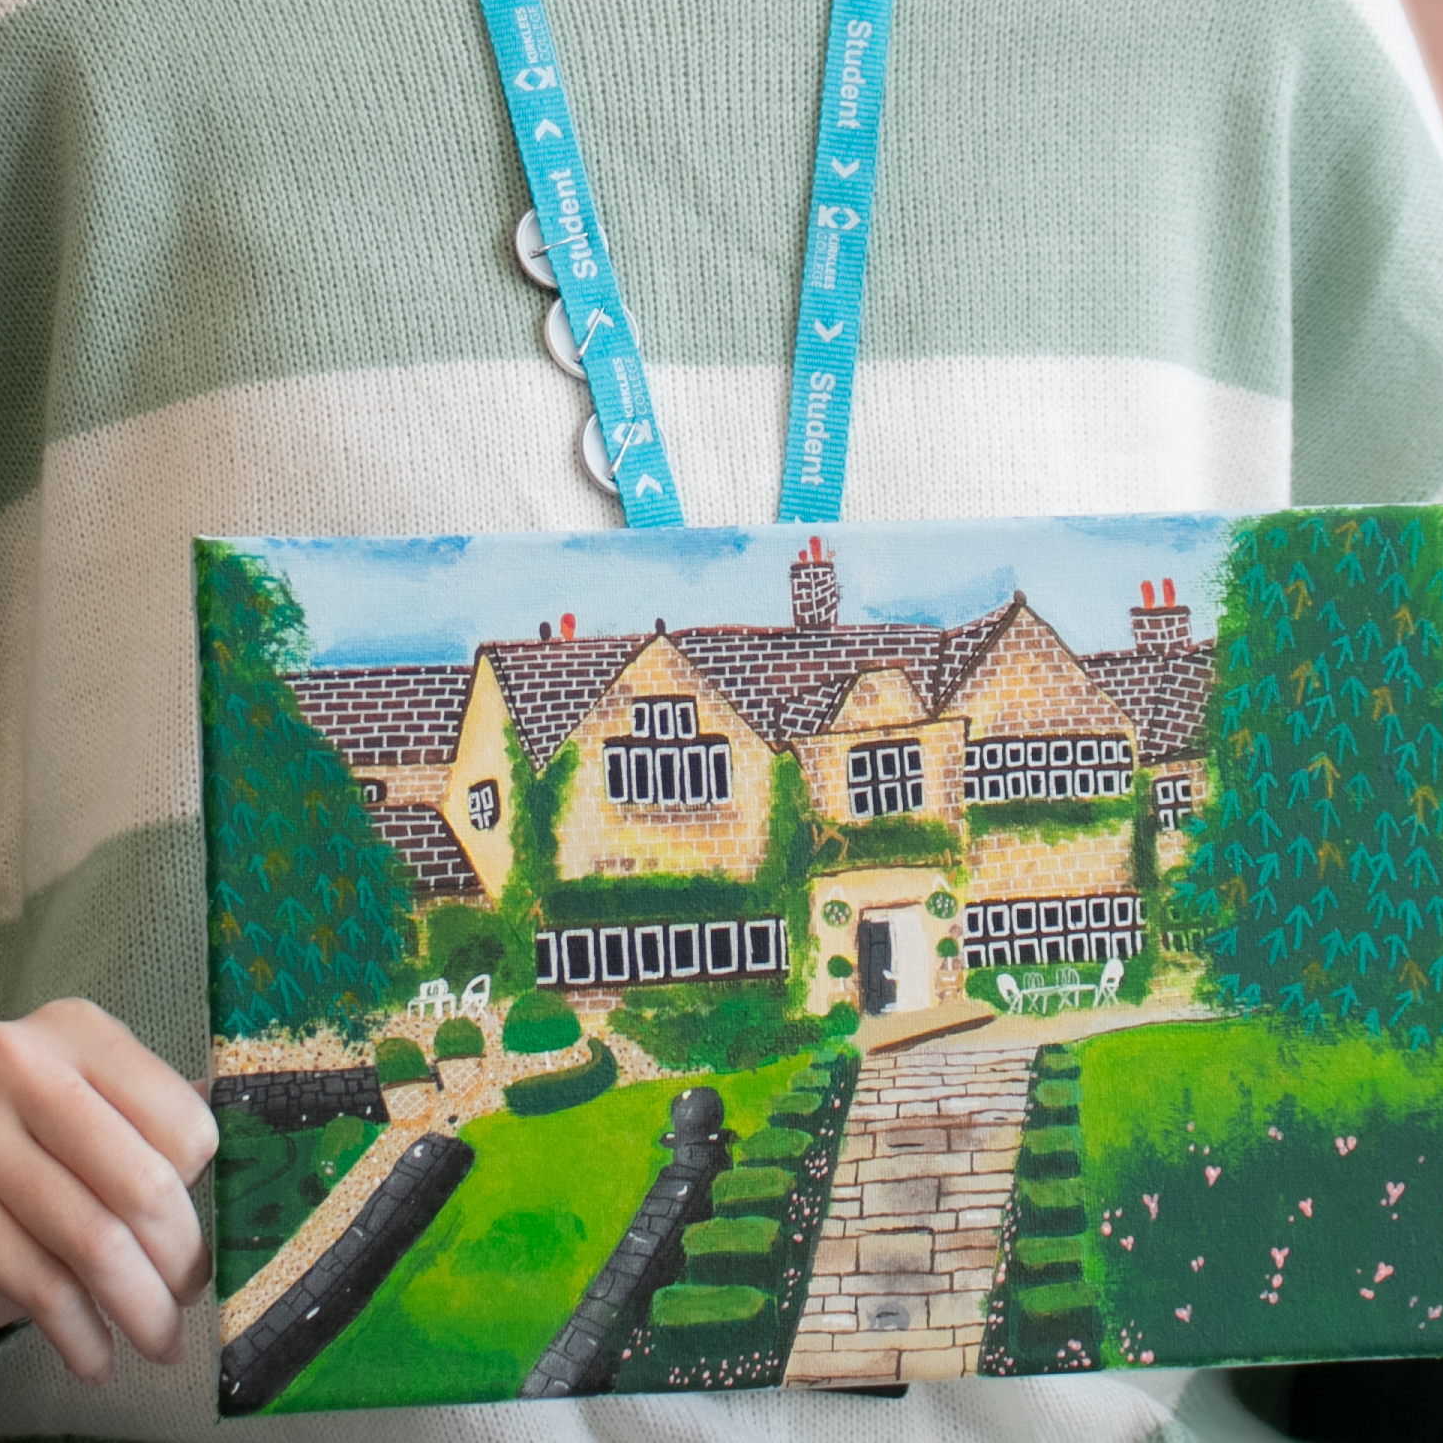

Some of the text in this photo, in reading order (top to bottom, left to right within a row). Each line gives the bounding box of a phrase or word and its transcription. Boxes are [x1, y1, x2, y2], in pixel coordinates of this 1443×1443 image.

[514, 6, 539, 64] KIRKLEES
[527, 5, 552, 62] COLLEGE
[836, 19, 873, 130] Student
[548, 167, 598, 279] Student
[810, 231, 827, 289] COLLEGE
[823, 233, 840, 291] KIRKLEES
[612, 357, 635, 419] KIRKLEES
[624, 355, 648, 416] COLLEGE
[800, 371, 837, 486] Student
